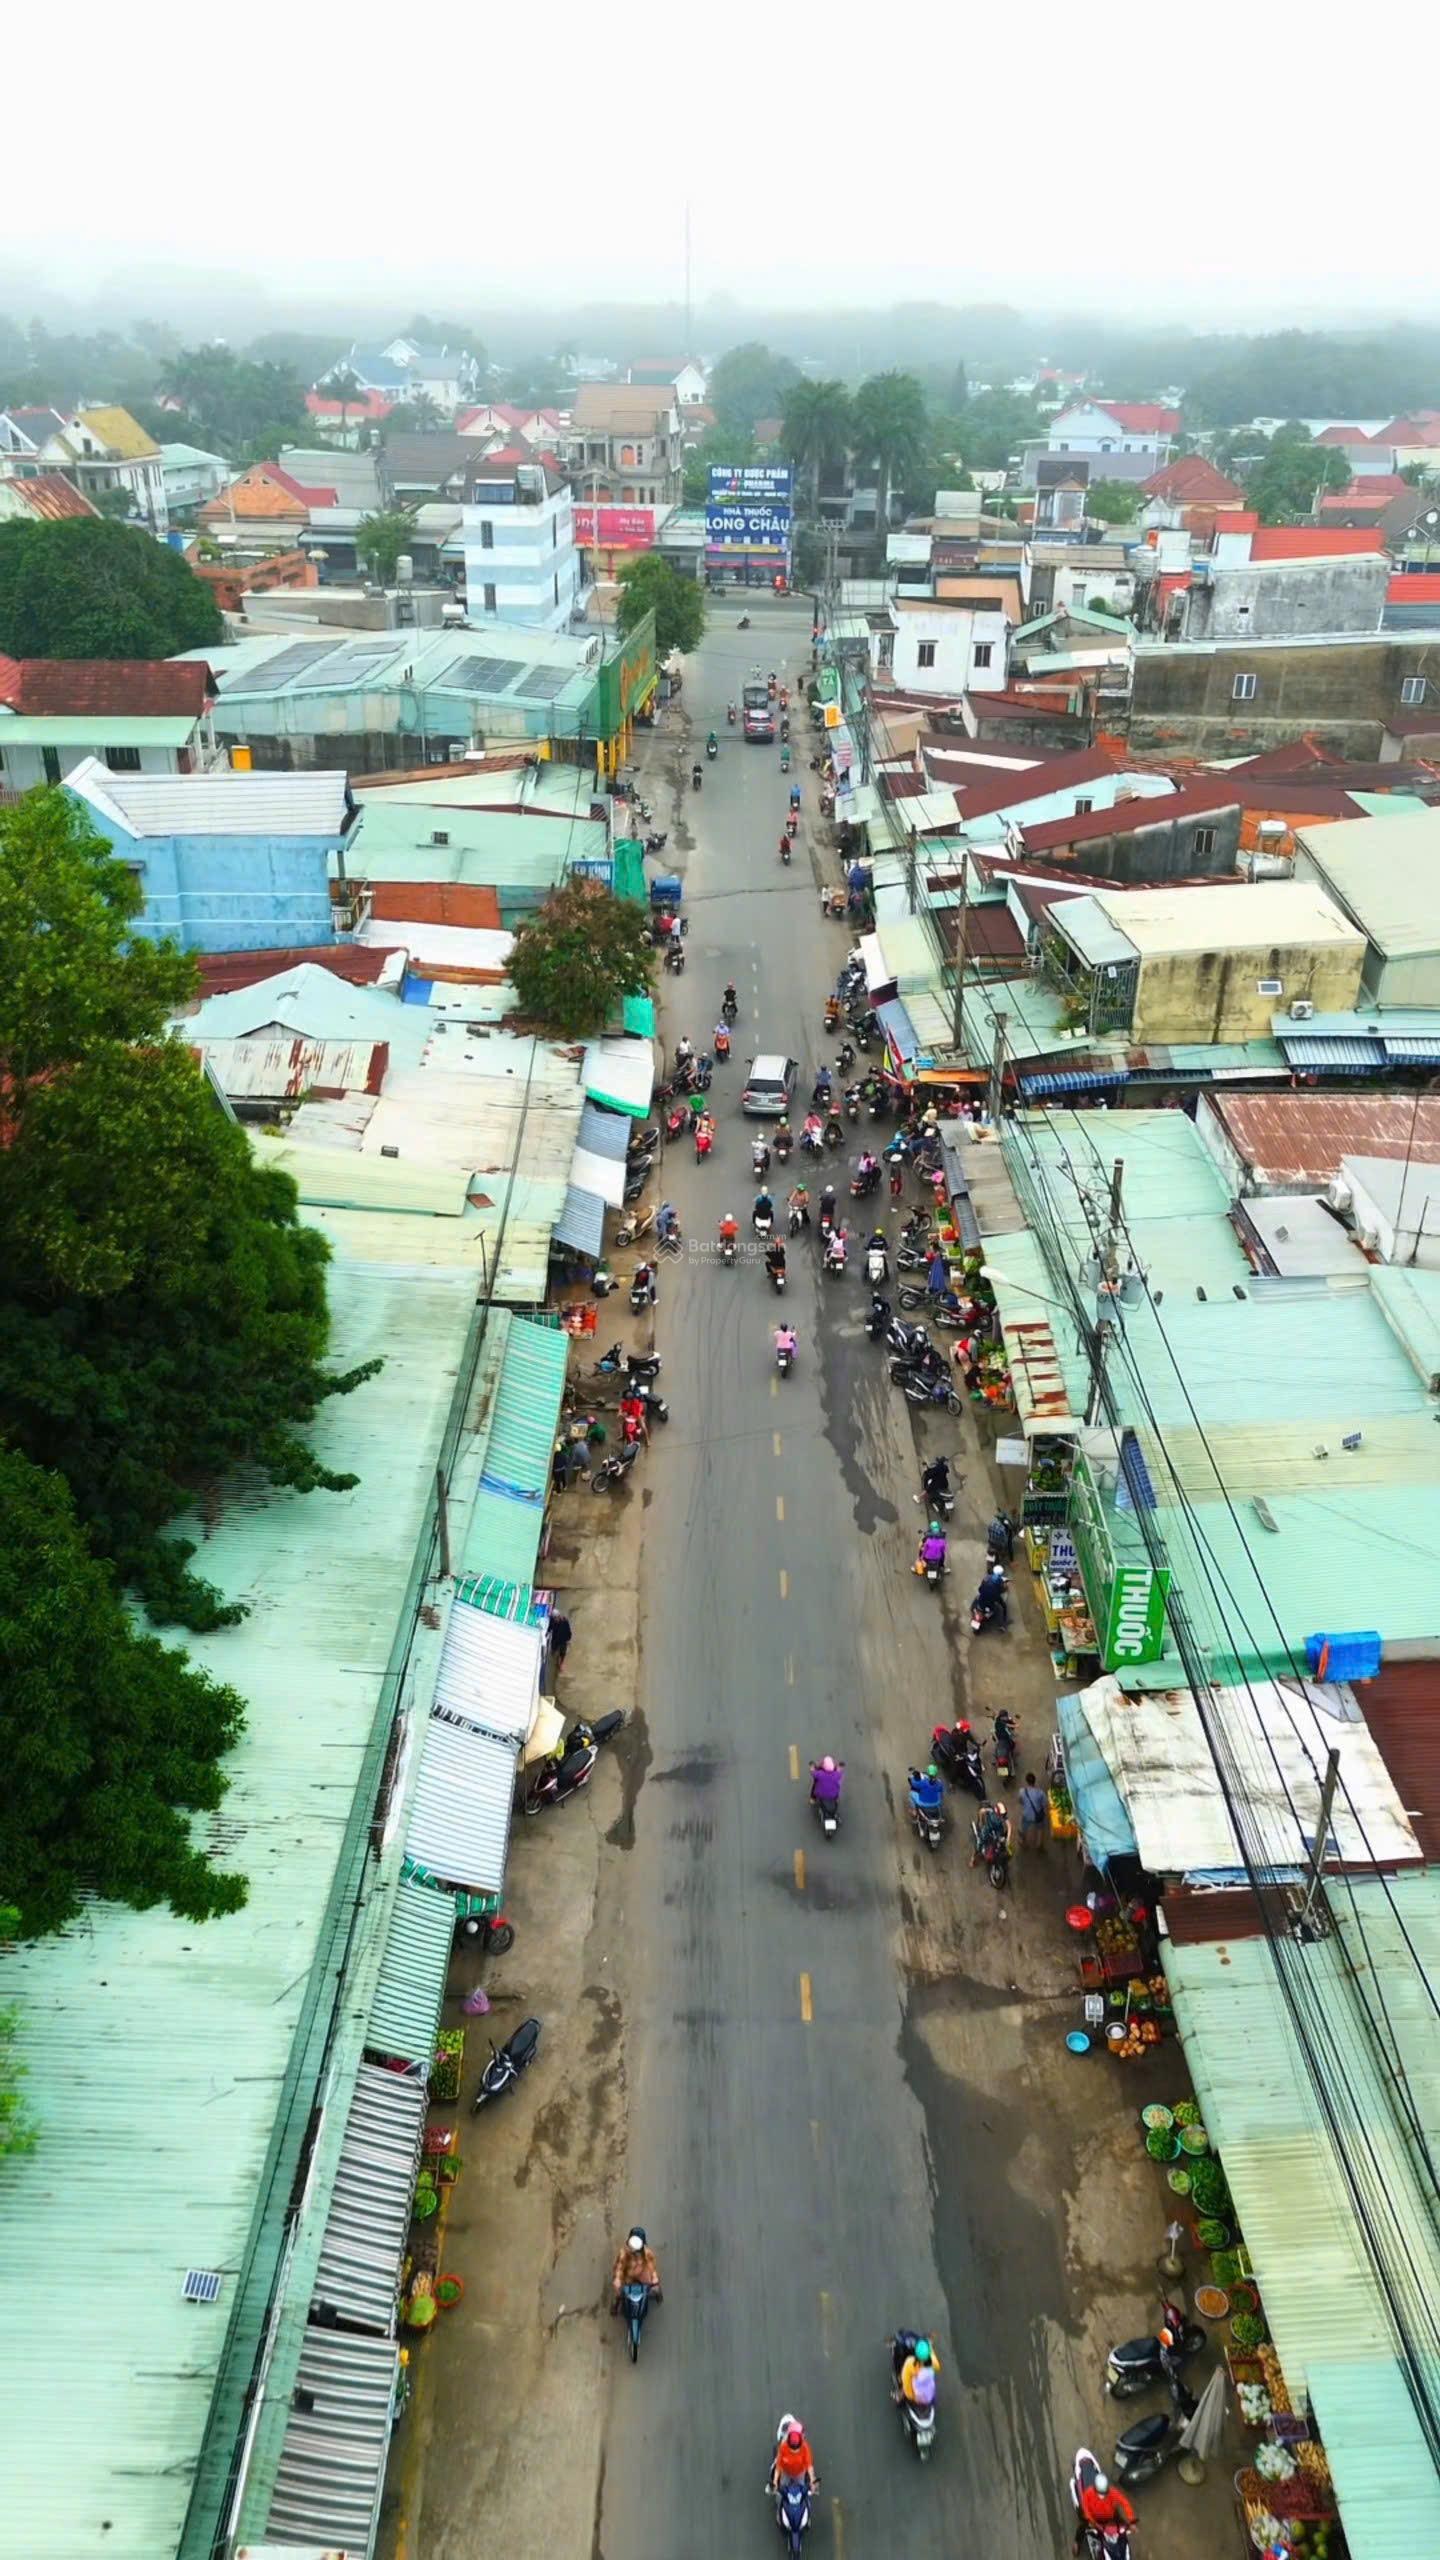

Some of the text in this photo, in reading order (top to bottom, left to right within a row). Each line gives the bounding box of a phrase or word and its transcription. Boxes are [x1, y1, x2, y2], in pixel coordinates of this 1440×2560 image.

[723, 505, 773, 517] NHÀ THUỐC
[706, 515, 790, 532] LONG CHÂU
[1053, 1544, 1077, 1556] THU
[1113, 1570, 1154, 1657] THUỐC
